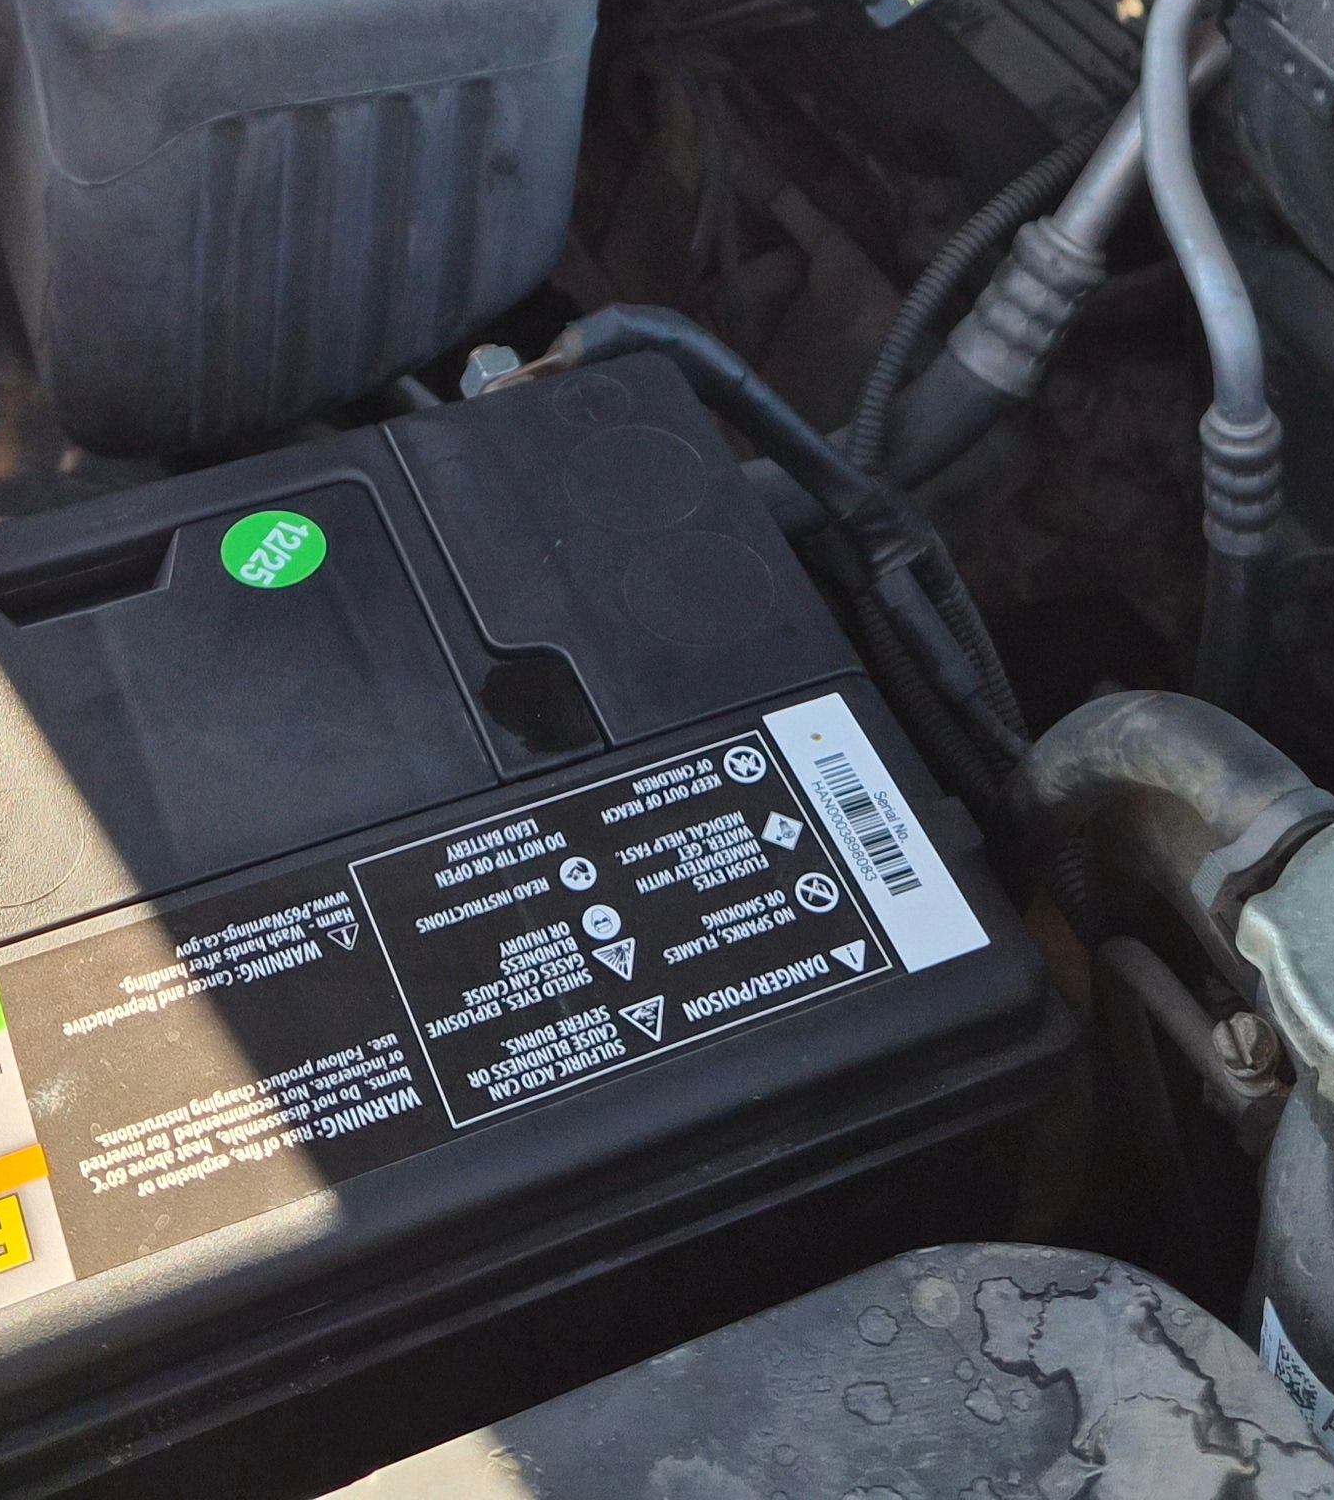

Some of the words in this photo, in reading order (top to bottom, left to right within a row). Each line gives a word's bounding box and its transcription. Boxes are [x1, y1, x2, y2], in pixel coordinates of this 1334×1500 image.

[239, 521, 309, 587] 12/25
[632, 764, 695, 795] CHILDREN
[696, 758, 714, 775] OF
[662, 784, 689, 804] OUT
[690, 773, 723, 795] KEEP
[600, 798, 645, 825] REACH
[645, 793, 663, 810] OF
[503, 818, 540, 842] LEAD
[685, 810, 745, 841] MEDICAL
[872, 789, 901, 825] Serial
[891, 822, 911, 845] No.
[544, 831, 567, 851] DO
[653, 830, 688, 853] HELP
[702, 825, 754, 851] WATER.
[810, 779, 878, 884] HAN0003898083
[446, 829, 505, 863] BATTERY
[495, 848, 519, 868] TIP
[517, 838, 546, 862] NOT
[614, 842, 653, 865] FAST.
[677, 842, 703, 862] GET
[471, 856, 494, 875] OR
[674, 838, 762, 881] IMMEDIATELY
[724, 853, 770, 881] FLUSH
[434, 862, 473, 888] OPEN
[512, 876, 550, 900] READ
[635, 869, 676, 894] WITH
[692, 868, 727, 892] EYES
[763, 889, 786, 907] OR
[175, 890, 350, 959] www.P65Warnings.ca.gov
[315, 906, 356, 929] Harm
[415, 889, 514, 934] INSTRUCTIONS
[700, 896, 766, 930] SMOKING
[773, 906, 797, 925] NO
[265, 923, 307, 948] Wash
[547, 921, 571, 940] OR
[716, 913, 774, 944] SPARKS,
[223, 936, 267, 962] hands
[499, 928, 550, 958] INJURY
[499, 935, 579, 976] BLINDNESS
[662, 933, 719, 965] FLAMES
[189, 951, 222, 973] after
[234, 939, 323, 983] WARNING:
[539, 952, 585, 980] GASES
[118, 962, 189, 995] handling.
[182, 970, 234, 1000] Cancer
[508, 968, 540, 991] CAN
[541, 967, 593, 997] SHIELD
[681, 953, 830, 1022] DANGER/POISON
[156, 984, 186, 1009] and
[461, 979, 509, 1007] CAUSE
[501, 986, 543, 1011] EYES.
[62, 993, 158, 1037] Reproductive
[424, 999, 503, 1039] EXPLOSIVE
[555, 1004, 611, 1037] SEVERE
[366, 1033, 399, 1051] use.
[500, 1024, 558, 1056] BURNS.
[569, 1022, 618, 1052] CAUSE
[316, 1045, 365, 1072] Follow
[388, 1049, 404, 1065] or
[490, 1038, 573, 1081] BLINDNESS
[554, 1038, 626, 1077] SULFURIC
[255, 1059, 315, 1095] product
[309, 1055, 388, 1091] incinerate.
[364, 1065, 413, 1090] burns.
[466, 1068, 491, 1088] OR
[520, 1064, 556, 1089] ACID
[189, 1084, 256, 1117] charging
[280, 1083, 310, 1105] Not
[310, 1091, 339, 1113] not
[339, 1083, 362, 1101] Do
[487, 1078, 521, 1102] CAN
[172, 1095, 280, 1146] recommended
[215, 1103, 310, 1146] disassemble,
[313, 1086, 423, 1139] WARNING:
[94, 1106, 192, 1148] instructions.
[279, 1124, 314, 1148] Risk
[146, 1132, 171, 1152] for
[174, 1136, 214, 1162] heat
[229, 1141, 264, 1162] fire,
[262, 1136, 281, 1158] of
[78, 1140, 147, 1179] inverted
[127, 1149, 175, 1177] above
[155, 1153, 231, 1190] explosion
[137, 1179, 156, 1197] or
